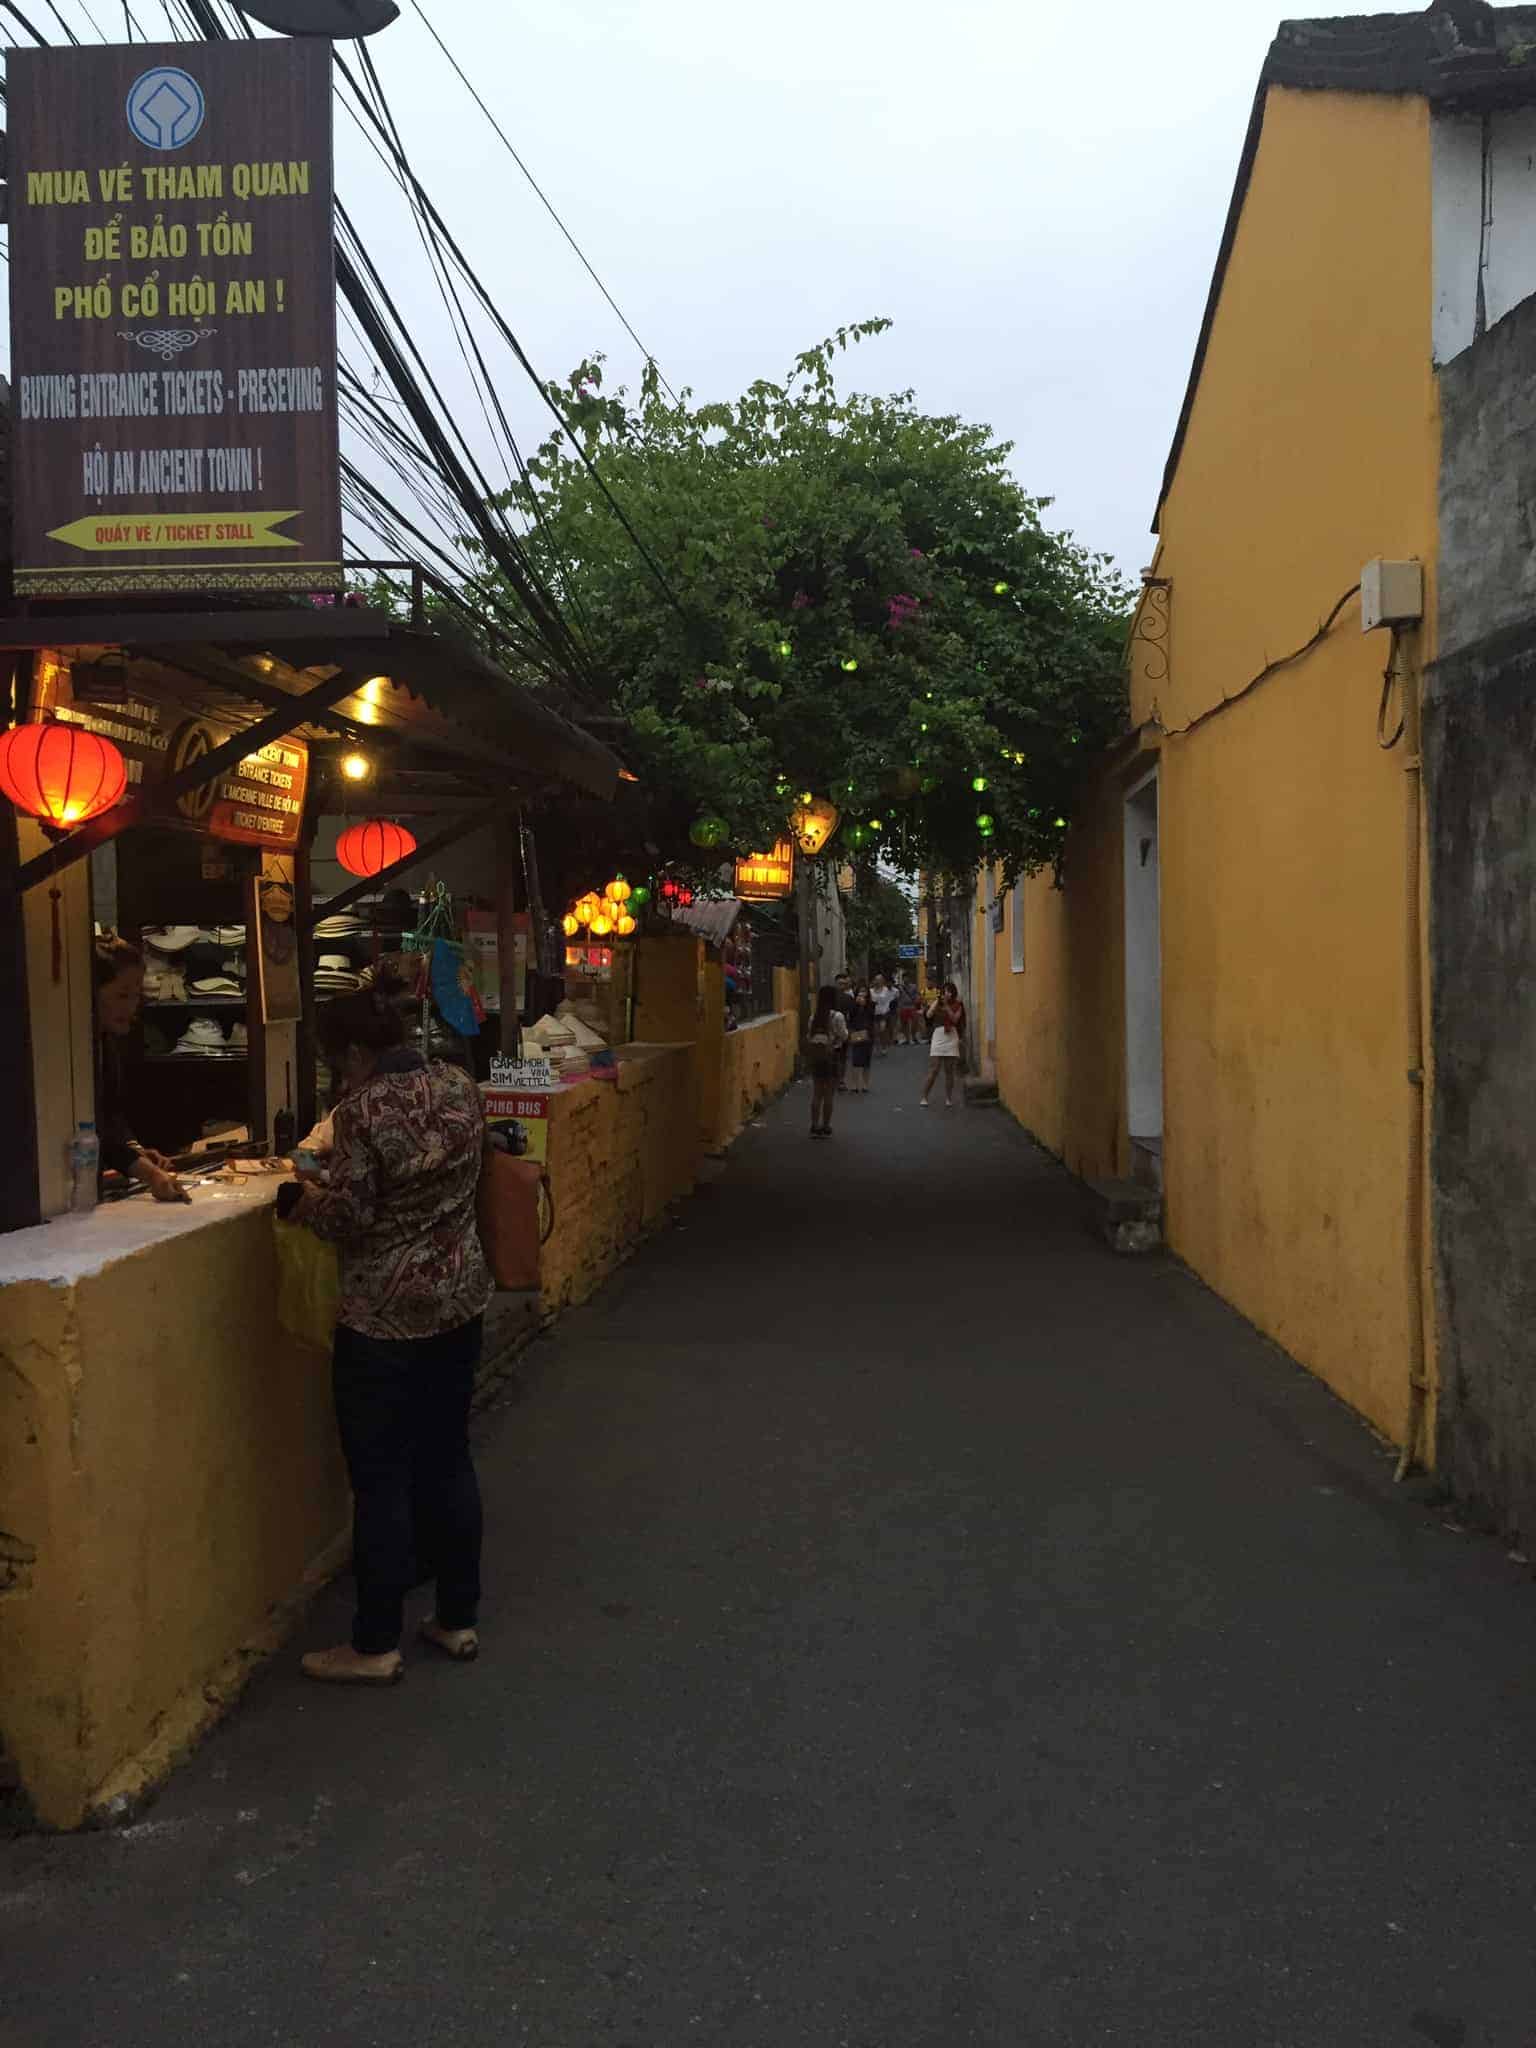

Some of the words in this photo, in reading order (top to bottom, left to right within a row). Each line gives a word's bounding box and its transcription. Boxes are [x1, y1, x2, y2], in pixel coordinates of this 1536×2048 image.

[27, 171, 91, 205] MUA
[99, 161, 133, 202] VÉ
[142, 165, 222, 200] THAM
[232, 160, 309, 200] QUAN
[84, 213, 121, 260] ĐỂ
[130, 213, 187, 259] BẢO
[197, 210, 252, 257] TỒN
[55, 272, 112, 320] PHỐ
[121, 270, 159, 318] CỔ
[168, 275, 216, 322] HỘI
[225, 280, 265, 314] AN
[21, 374, 76, 419] BUYING
[80, 371, 159, 417] ENTRANCE
[162, 369, 223, 416] TICKETS
[238, 366, 323, 413] PRESEVING
[83, 442, 108, 505] HỘI
[113, 450, 135, 496] AN
[139, 449, 203, 495] ANCIENT
[207, 447, 252, 492] TOWN
[164, 524, 211, 542] TICKET
[215, 522, 256, 541] STALL
[238, 761, 270, 784] ENTRANCE
[492, 1072, 512, 1085] SIM
[517, 1102, 541, 1115] BUS
